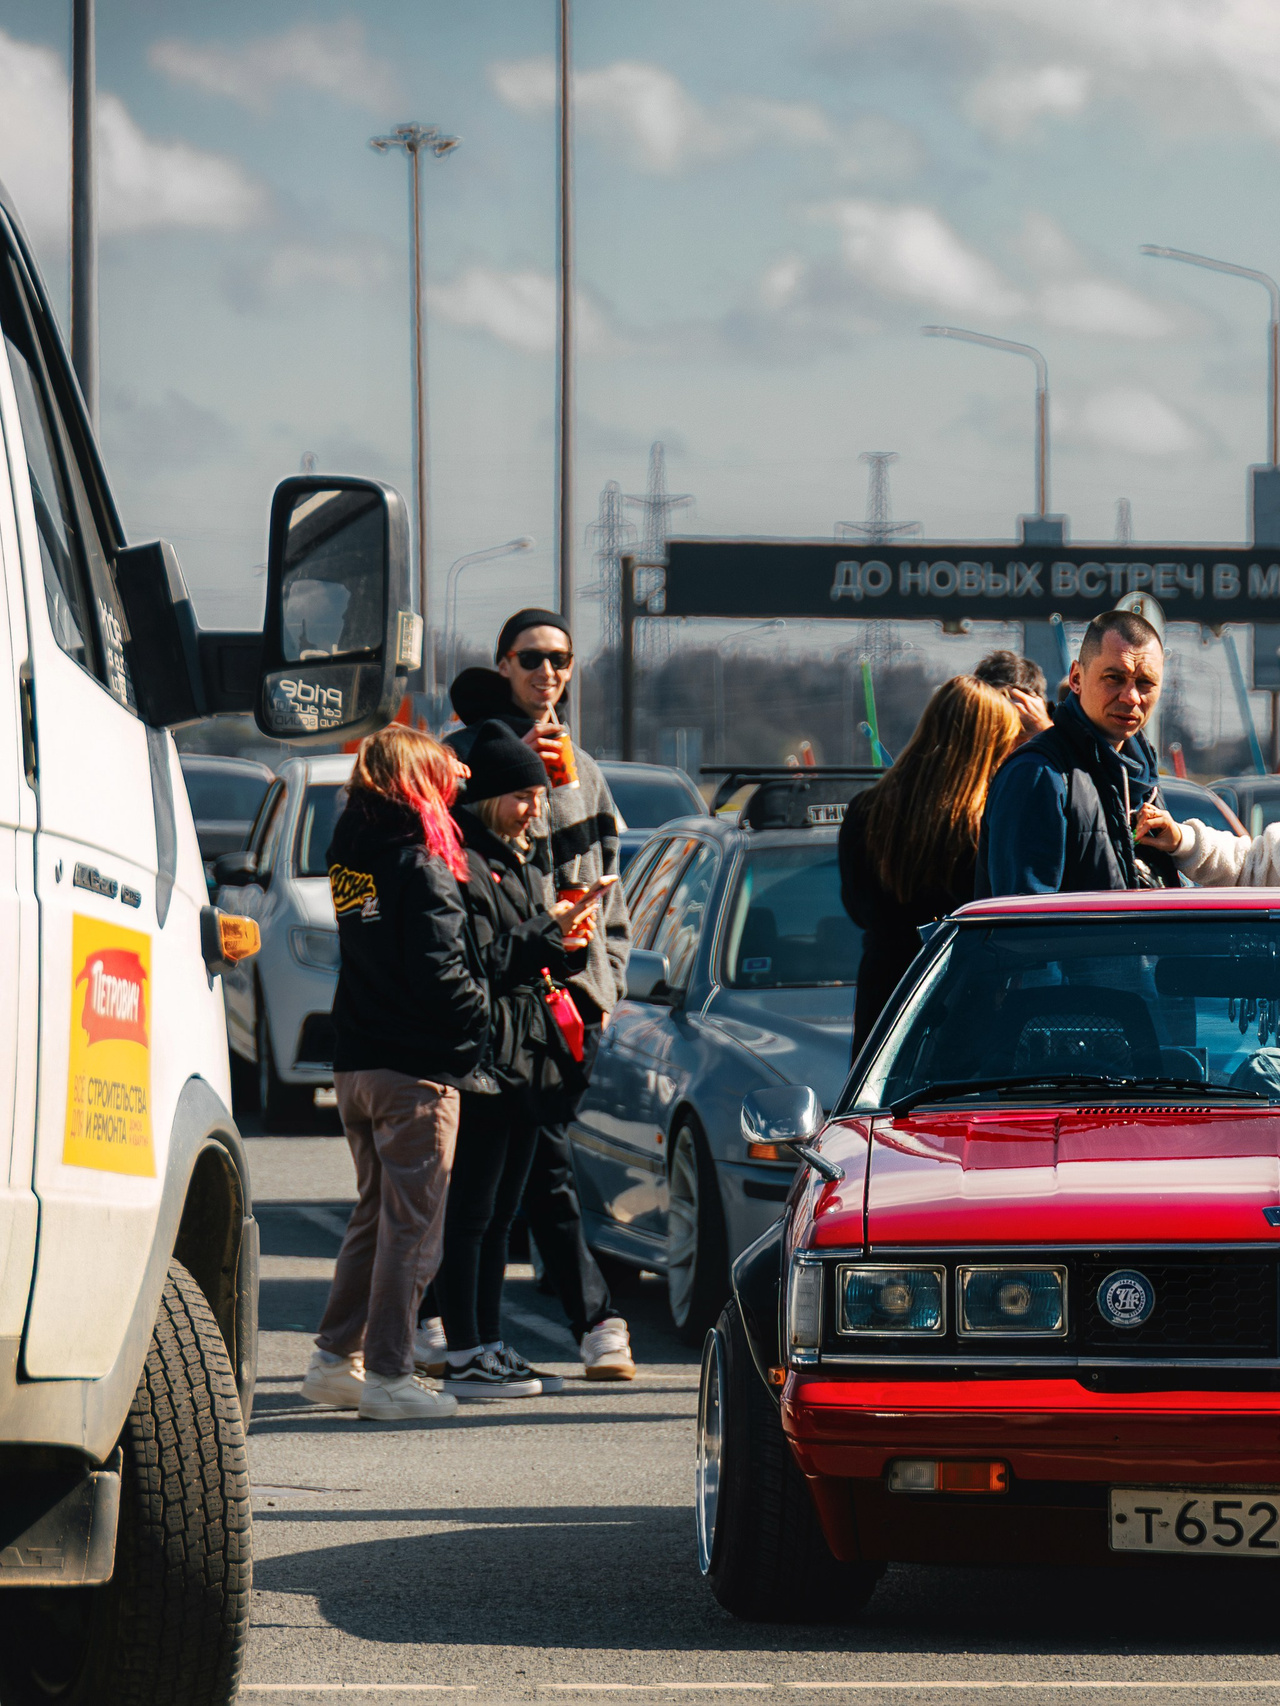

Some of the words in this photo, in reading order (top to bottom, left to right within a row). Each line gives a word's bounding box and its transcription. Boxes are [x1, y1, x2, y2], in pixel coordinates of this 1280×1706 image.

[829, 560, 892, 600] ДО
[900, 561, 1043, 597] НОВЫХ
[1051, 562, 1200, 599] ВСТРЕЧ
[1213, 564, 1240, 599] В
[92, 1112, 128, 1145] РЕМОНТА
